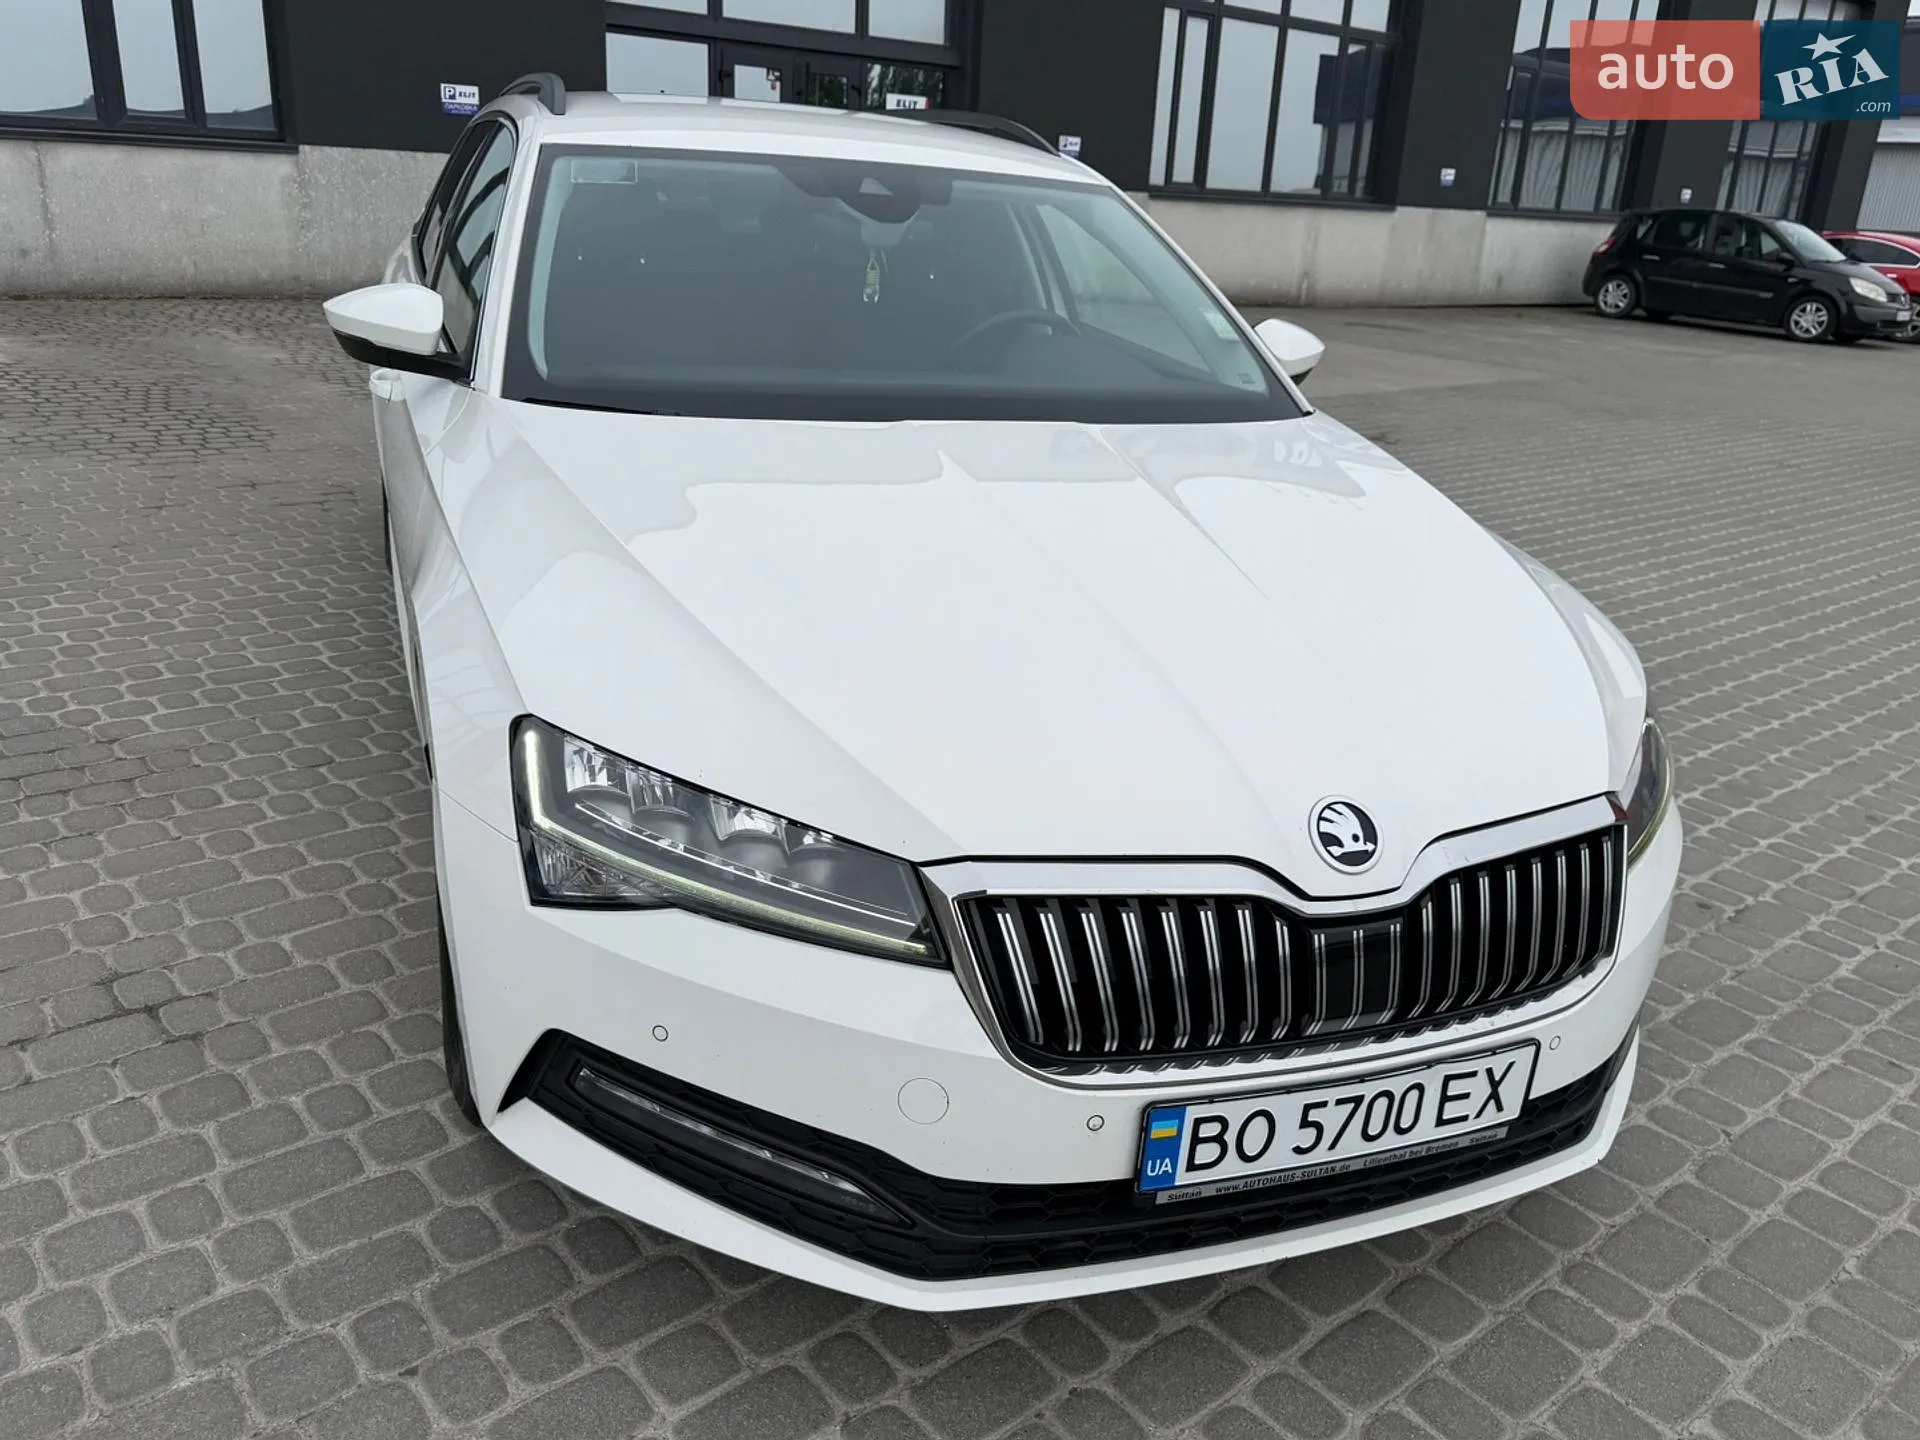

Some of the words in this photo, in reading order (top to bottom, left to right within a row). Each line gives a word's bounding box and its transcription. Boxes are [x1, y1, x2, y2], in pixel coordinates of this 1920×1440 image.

[896, 99, 918, 109] ELIT
[1185, 1109, 1276, 1172] BO
[1291, 1081, 1425, 1155] 5700
[1434, 1060, 1516, 1128] EX
[1147, 1158, 1172, 1176] UA
[1215, 1163, 1351, 1194] www.AUTOHAUS-SULTAN.de
[1363, 1151, 1407, 1167] Lilienthal
[1408, 1147, 1424, 1158] bei
[1425, 1141, 1460, 1154] Bremen
